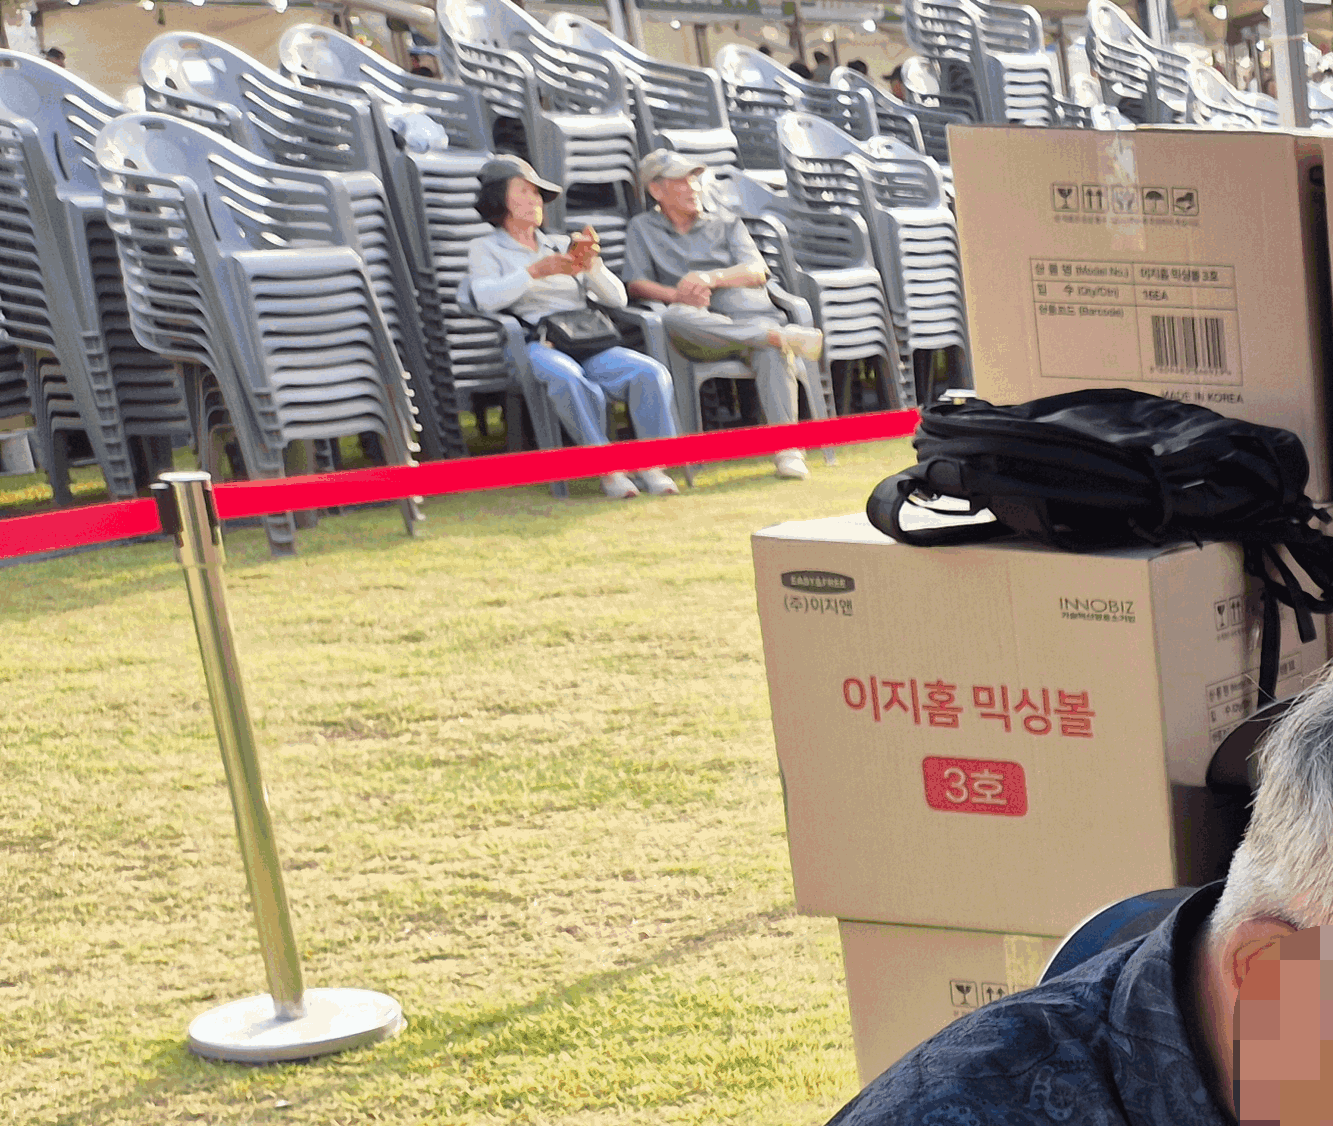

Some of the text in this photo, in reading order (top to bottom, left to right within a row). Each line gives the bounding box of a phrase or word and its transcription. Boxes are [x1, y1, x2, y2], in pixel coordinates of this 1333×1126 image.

[1207, 392, 1244, 404] KOREA
[1059, 596, 1135, 614] INNOBIZ
[843, 675, 1096, 739] 이지홈 믹싱볼
[943, 766, 1008, 806] 3호
